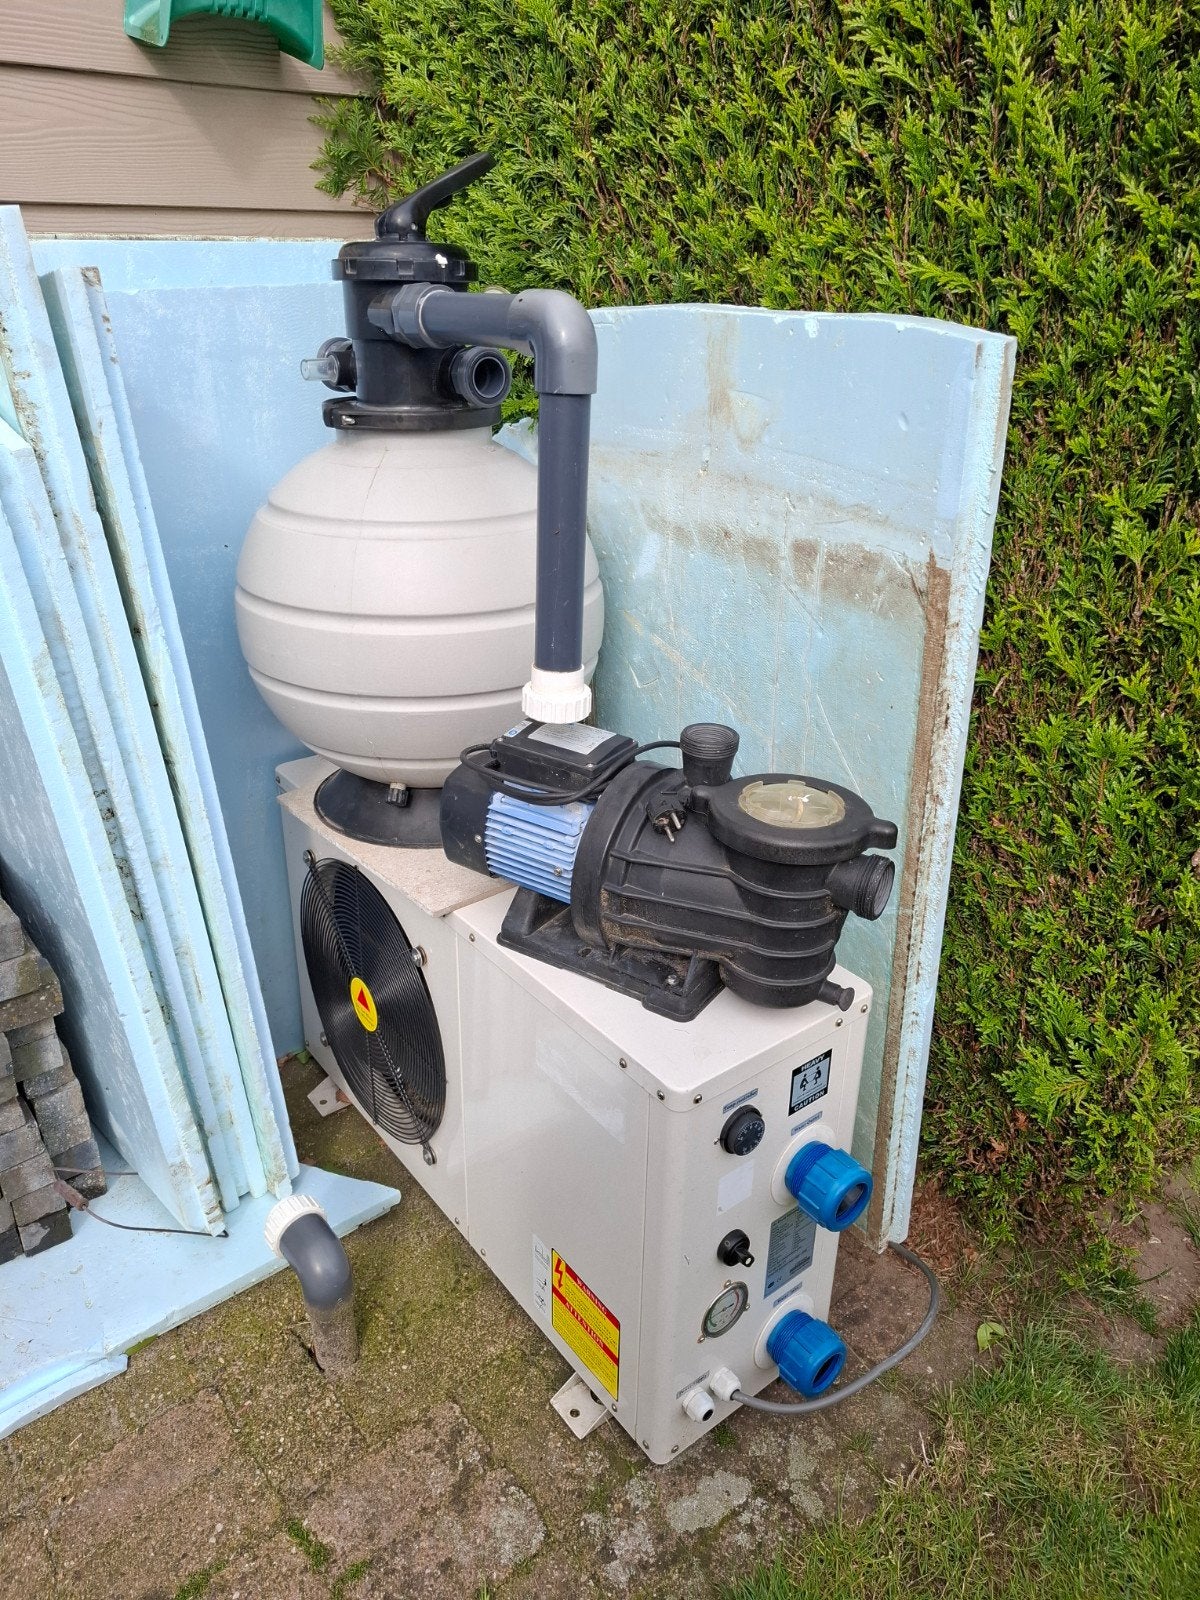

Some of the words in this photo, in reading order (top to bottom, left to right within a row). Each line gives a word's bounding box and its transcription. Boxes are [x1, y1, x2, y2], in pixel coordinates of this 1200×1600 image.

[801, 1054, 825, 1071] HEAVY
[793, 1090, 825, 1112] CAUTION
[576, 1277, 607, 1314] WARNING
[565, 1301, 604, 1348] ATTENTION
